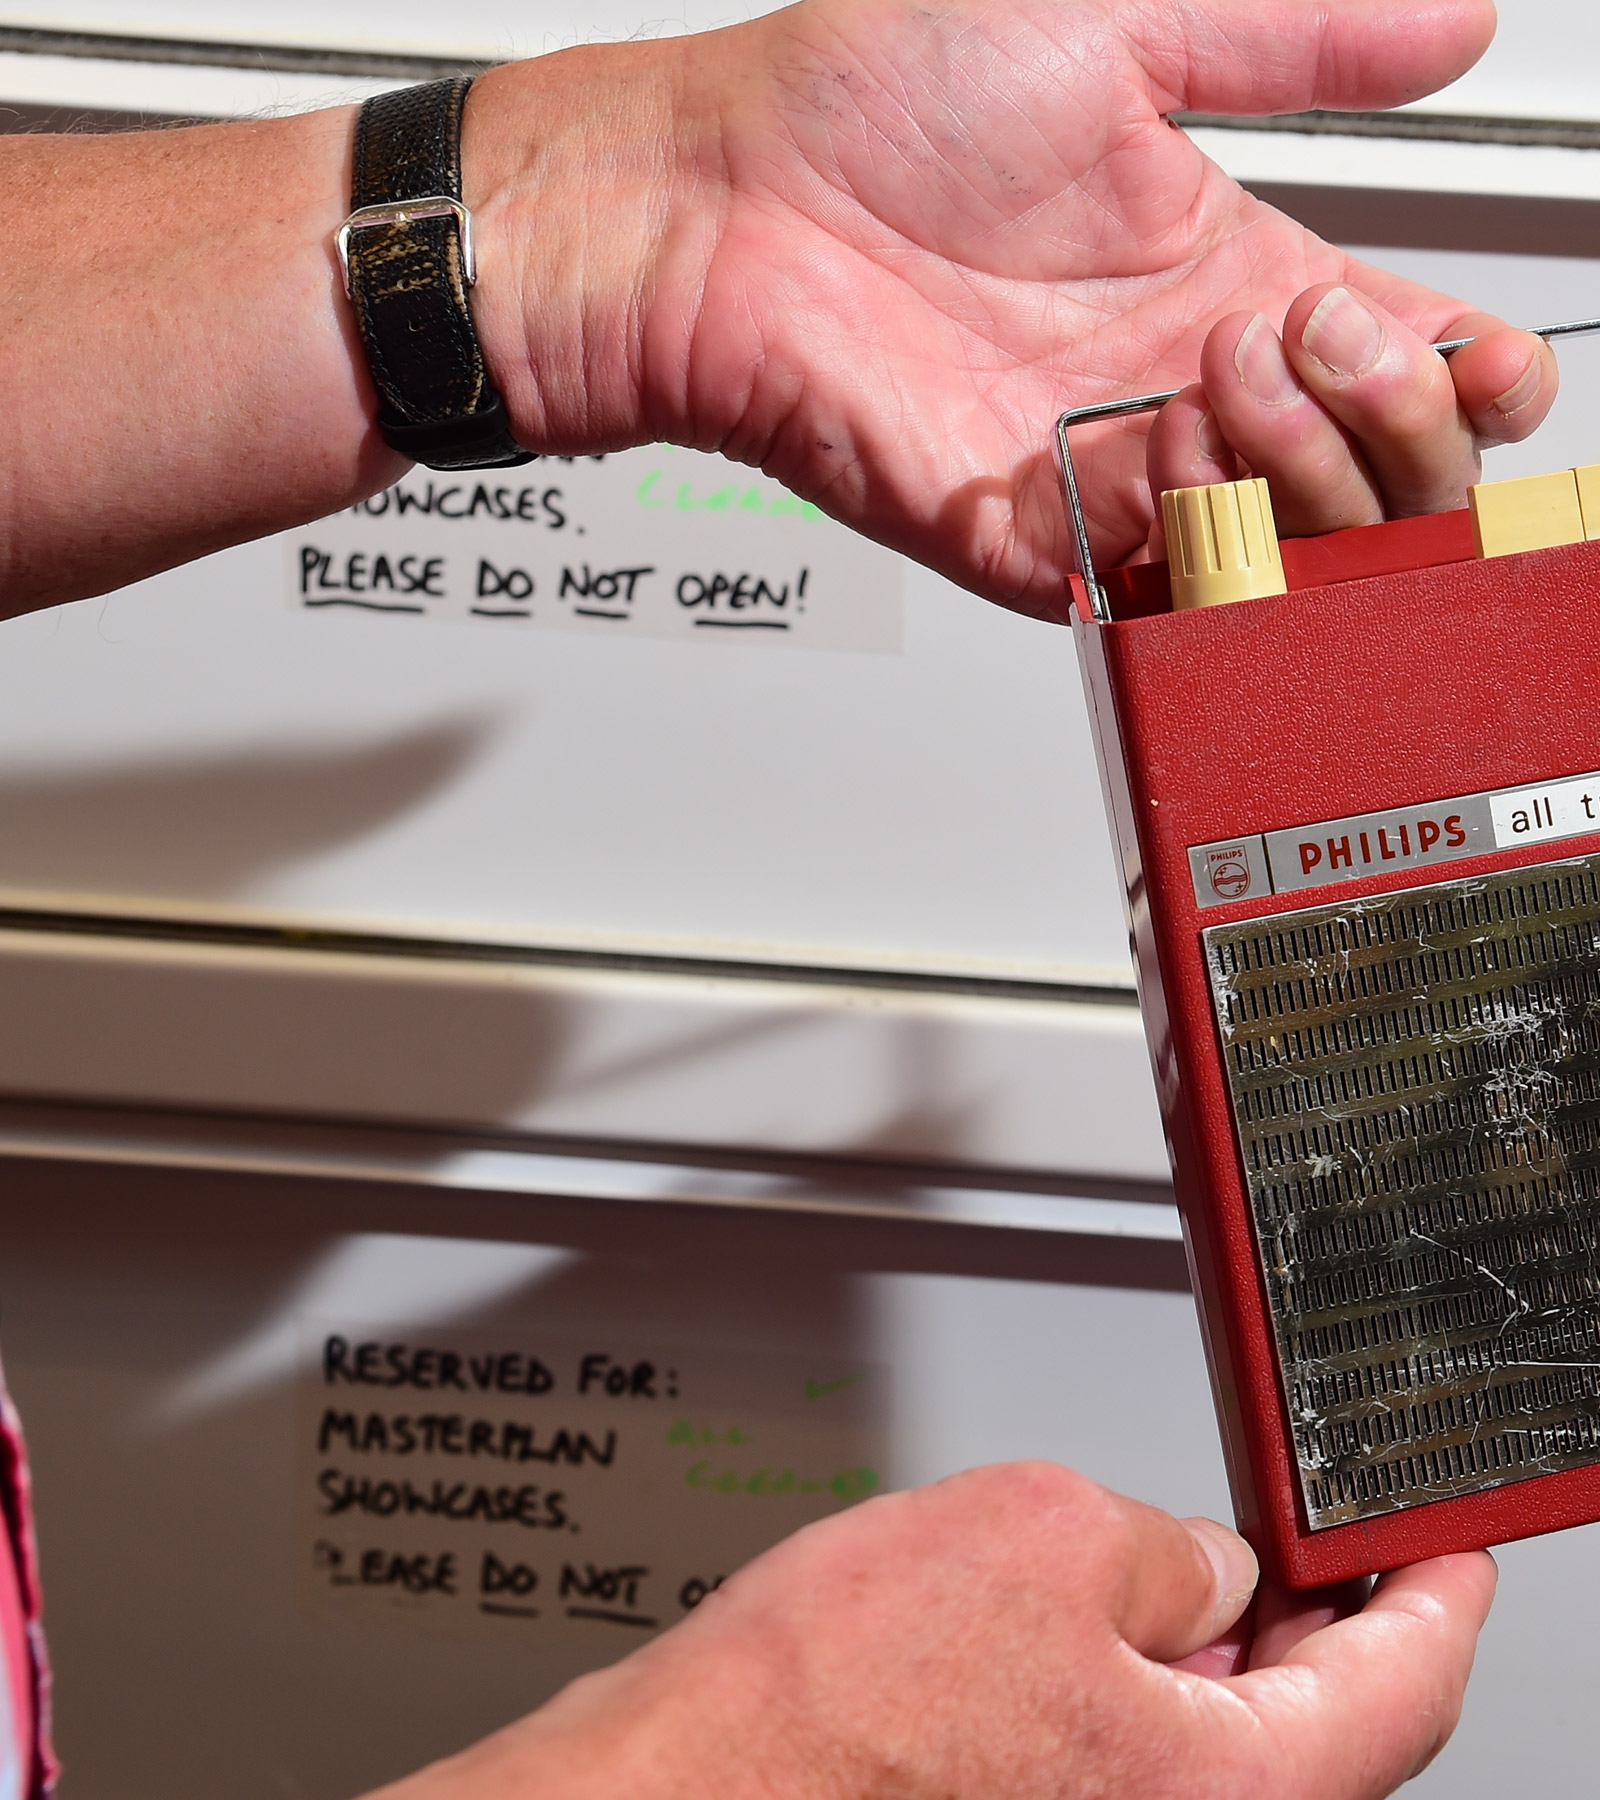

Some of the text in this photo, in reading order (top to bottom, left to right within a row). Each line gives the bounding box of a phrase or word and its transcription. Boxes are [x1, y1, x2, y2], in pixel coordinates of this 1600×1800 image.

[350, 480, 586, 534] OWCASES.
[299, 546, 809, 613] PLEASE DO NOT OPEN!
[1211, 849, 1243, 862] PHILIPS
[1299, 815, 1466, 875] PHILIPS
[1511, 796, 1554, 833] all
[324, 1335, 680, 1399] RESERVED FOR:
[317, 1409, 617, 1467] MASTERPLAN
[317, 1469, 581, 1535] SHOWCASES.
[480, 1550, 539, 1595] DO
[559, 1563, 650, 1606] NOT
